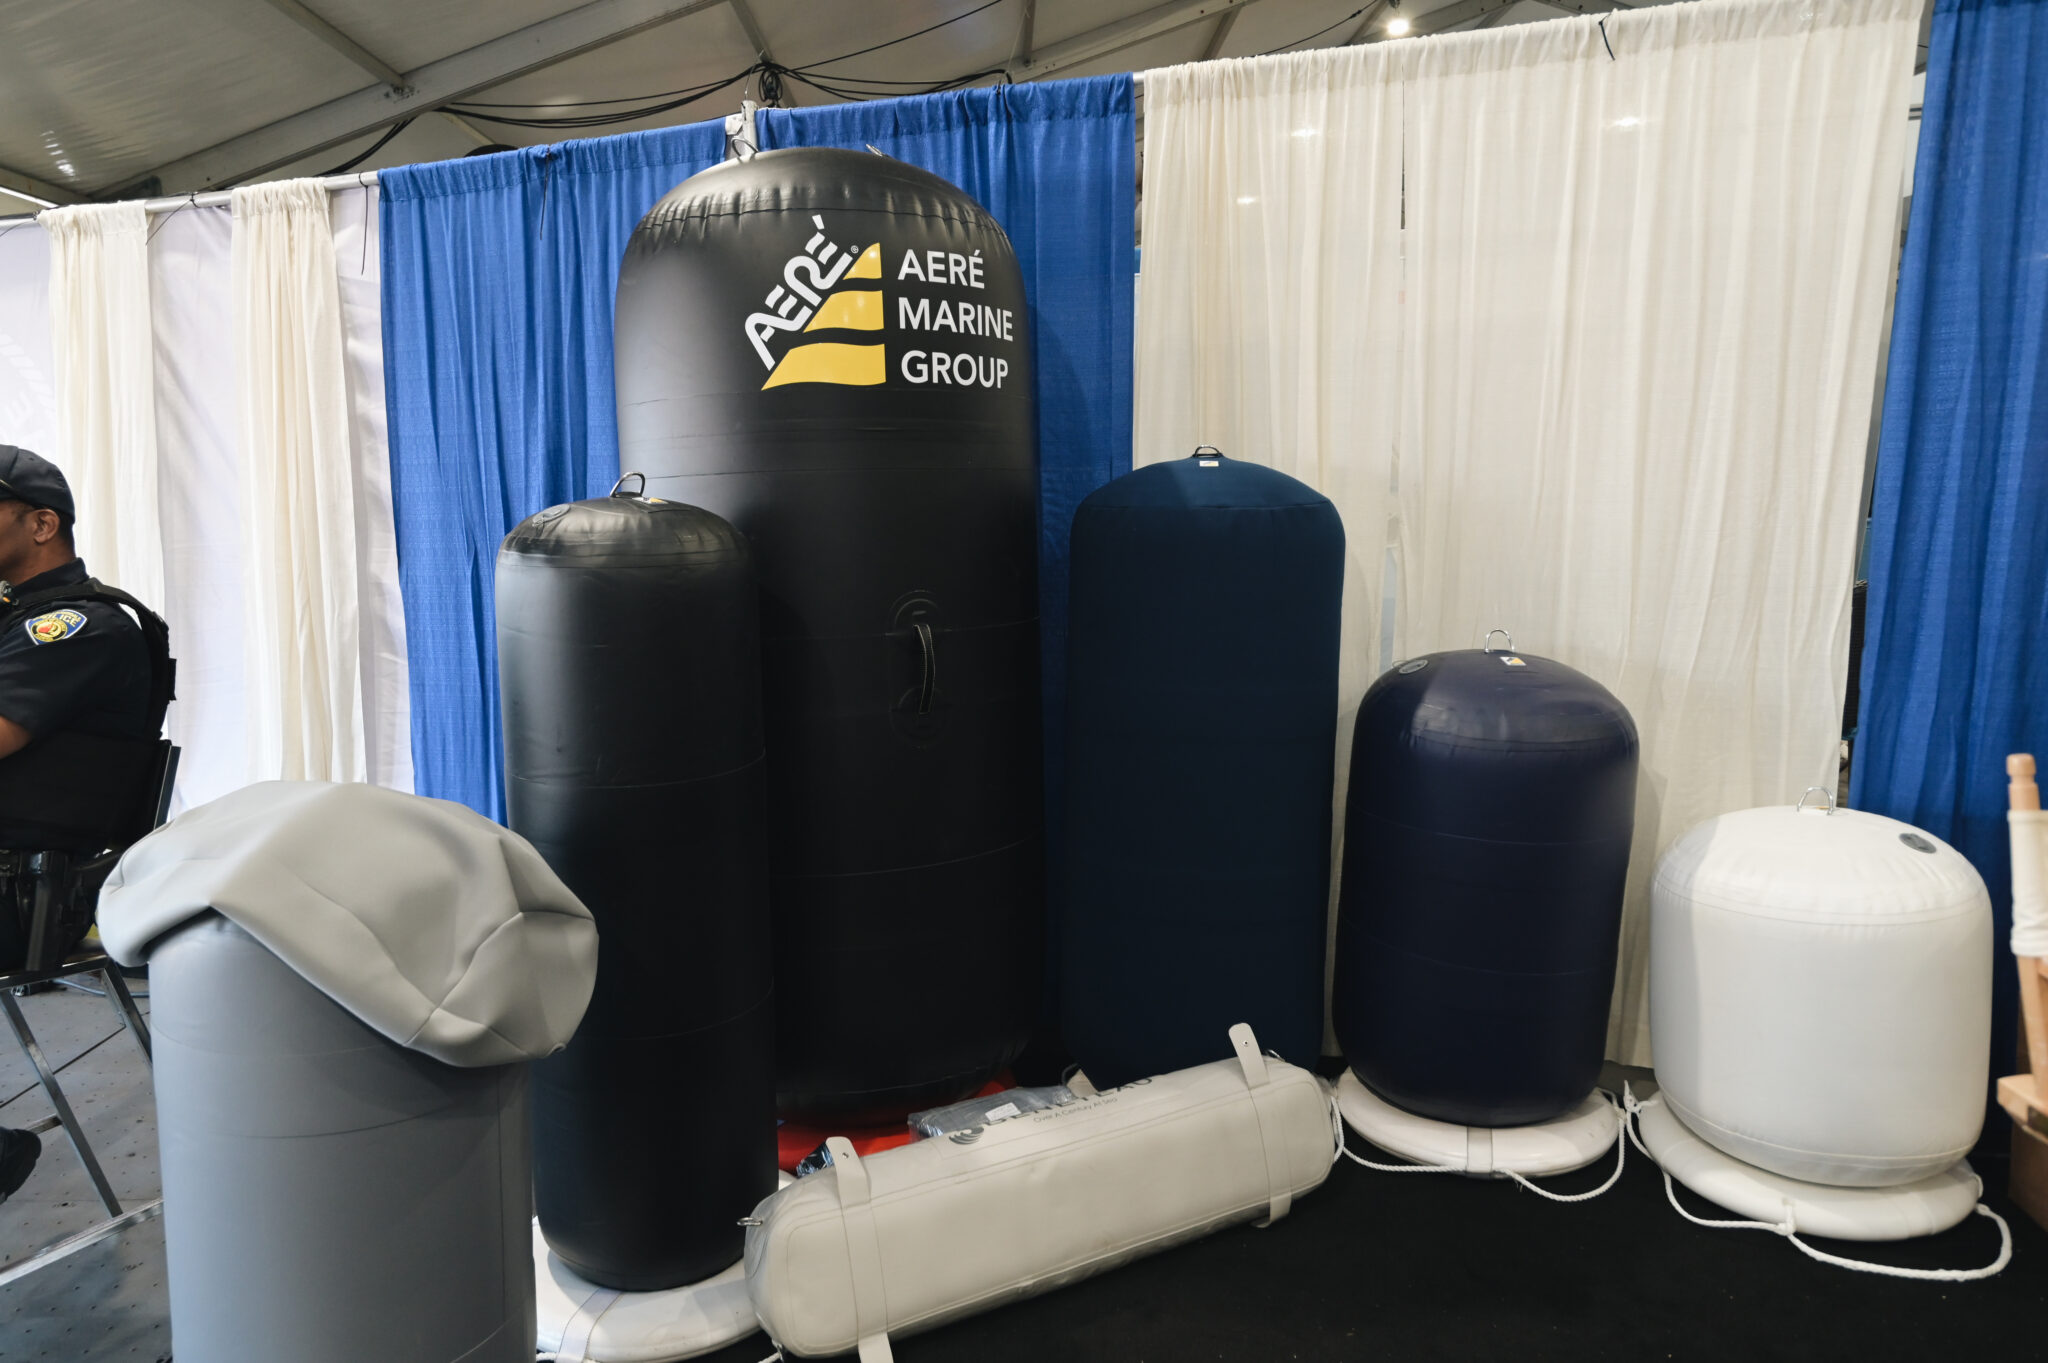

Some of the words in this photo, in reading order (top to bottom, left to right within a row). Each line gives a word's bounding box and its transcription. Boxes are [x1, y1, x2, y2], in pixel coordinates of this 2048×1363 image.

[897, 248, 985, 289] AERÉ
[898, 296, 1014, 342] MARINE
[901, 349, 1009, 389] GROUP
